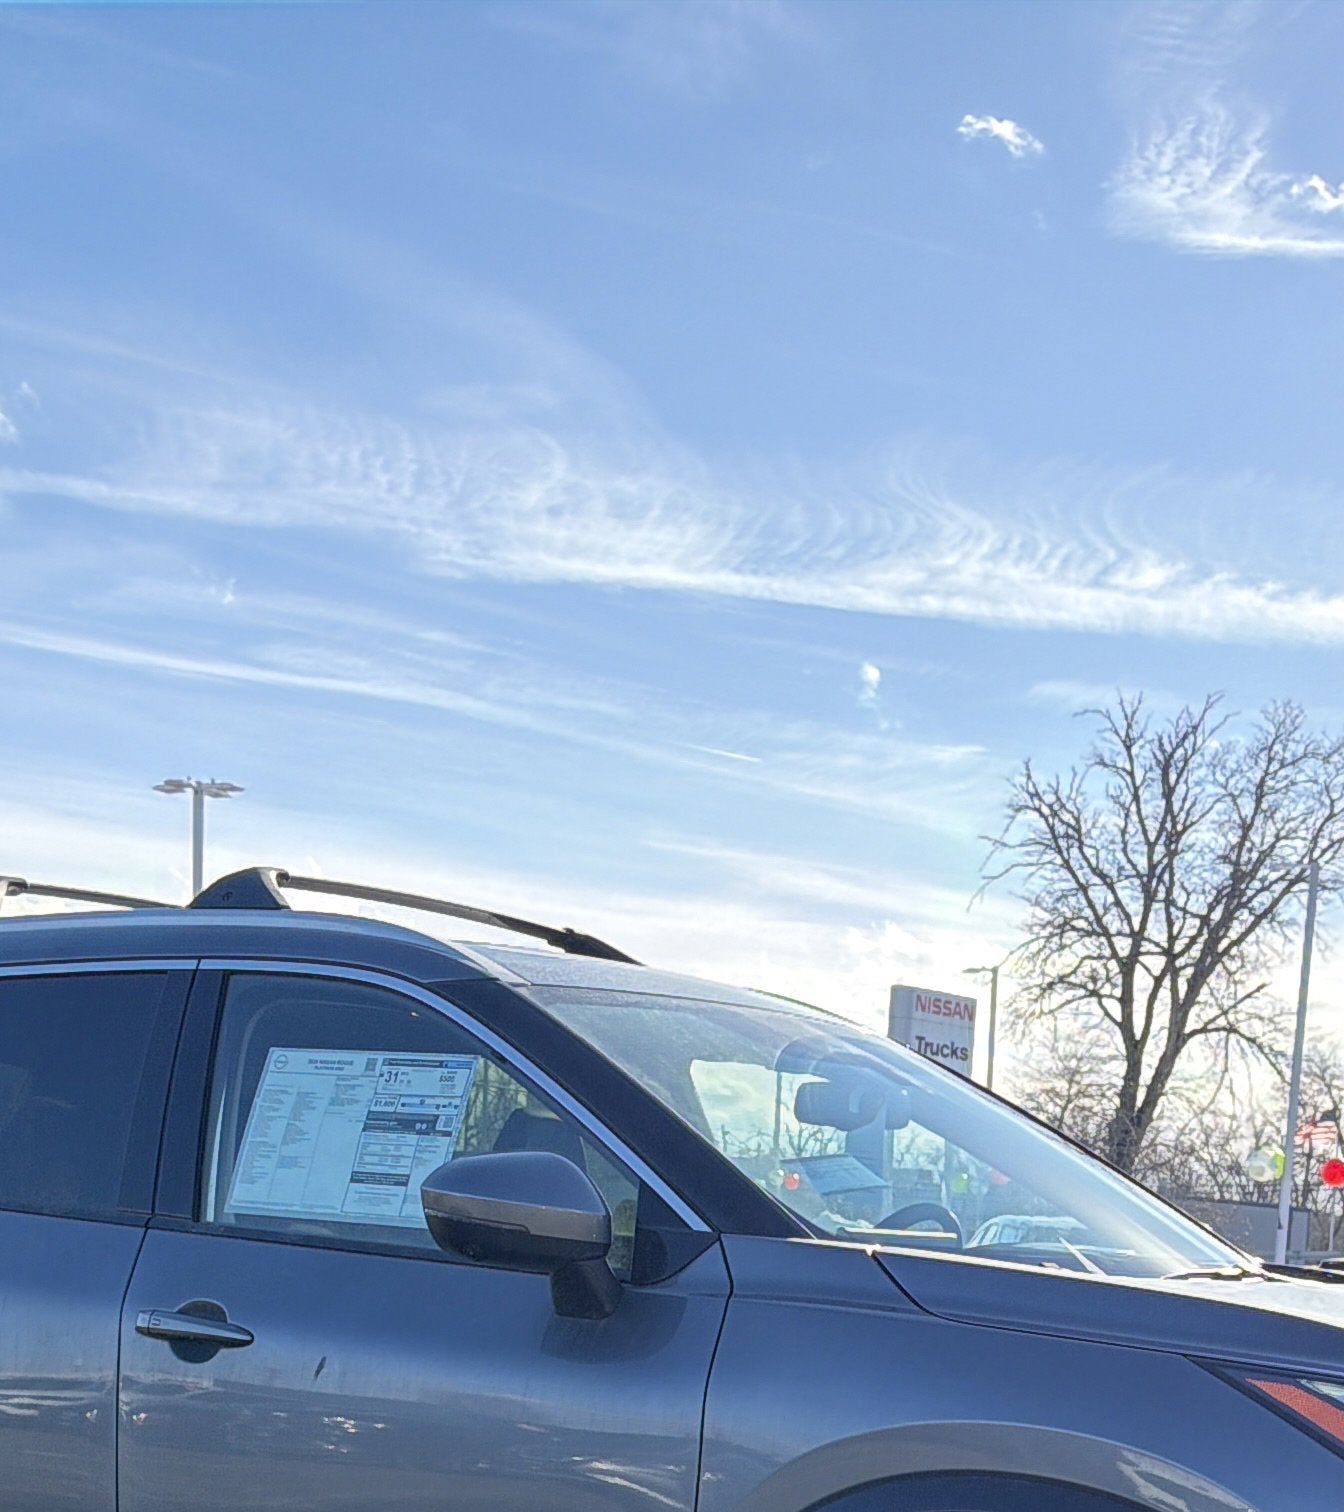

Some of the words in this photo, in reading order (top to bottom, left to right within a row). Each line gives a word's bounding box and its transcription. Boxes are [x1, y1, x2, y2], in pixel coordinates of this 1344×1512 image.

[915, 994, 974, 1021] NISSAN
[915, 1035, 969, 1061] Trucks
[384, 1071, 399, 1083] 31
